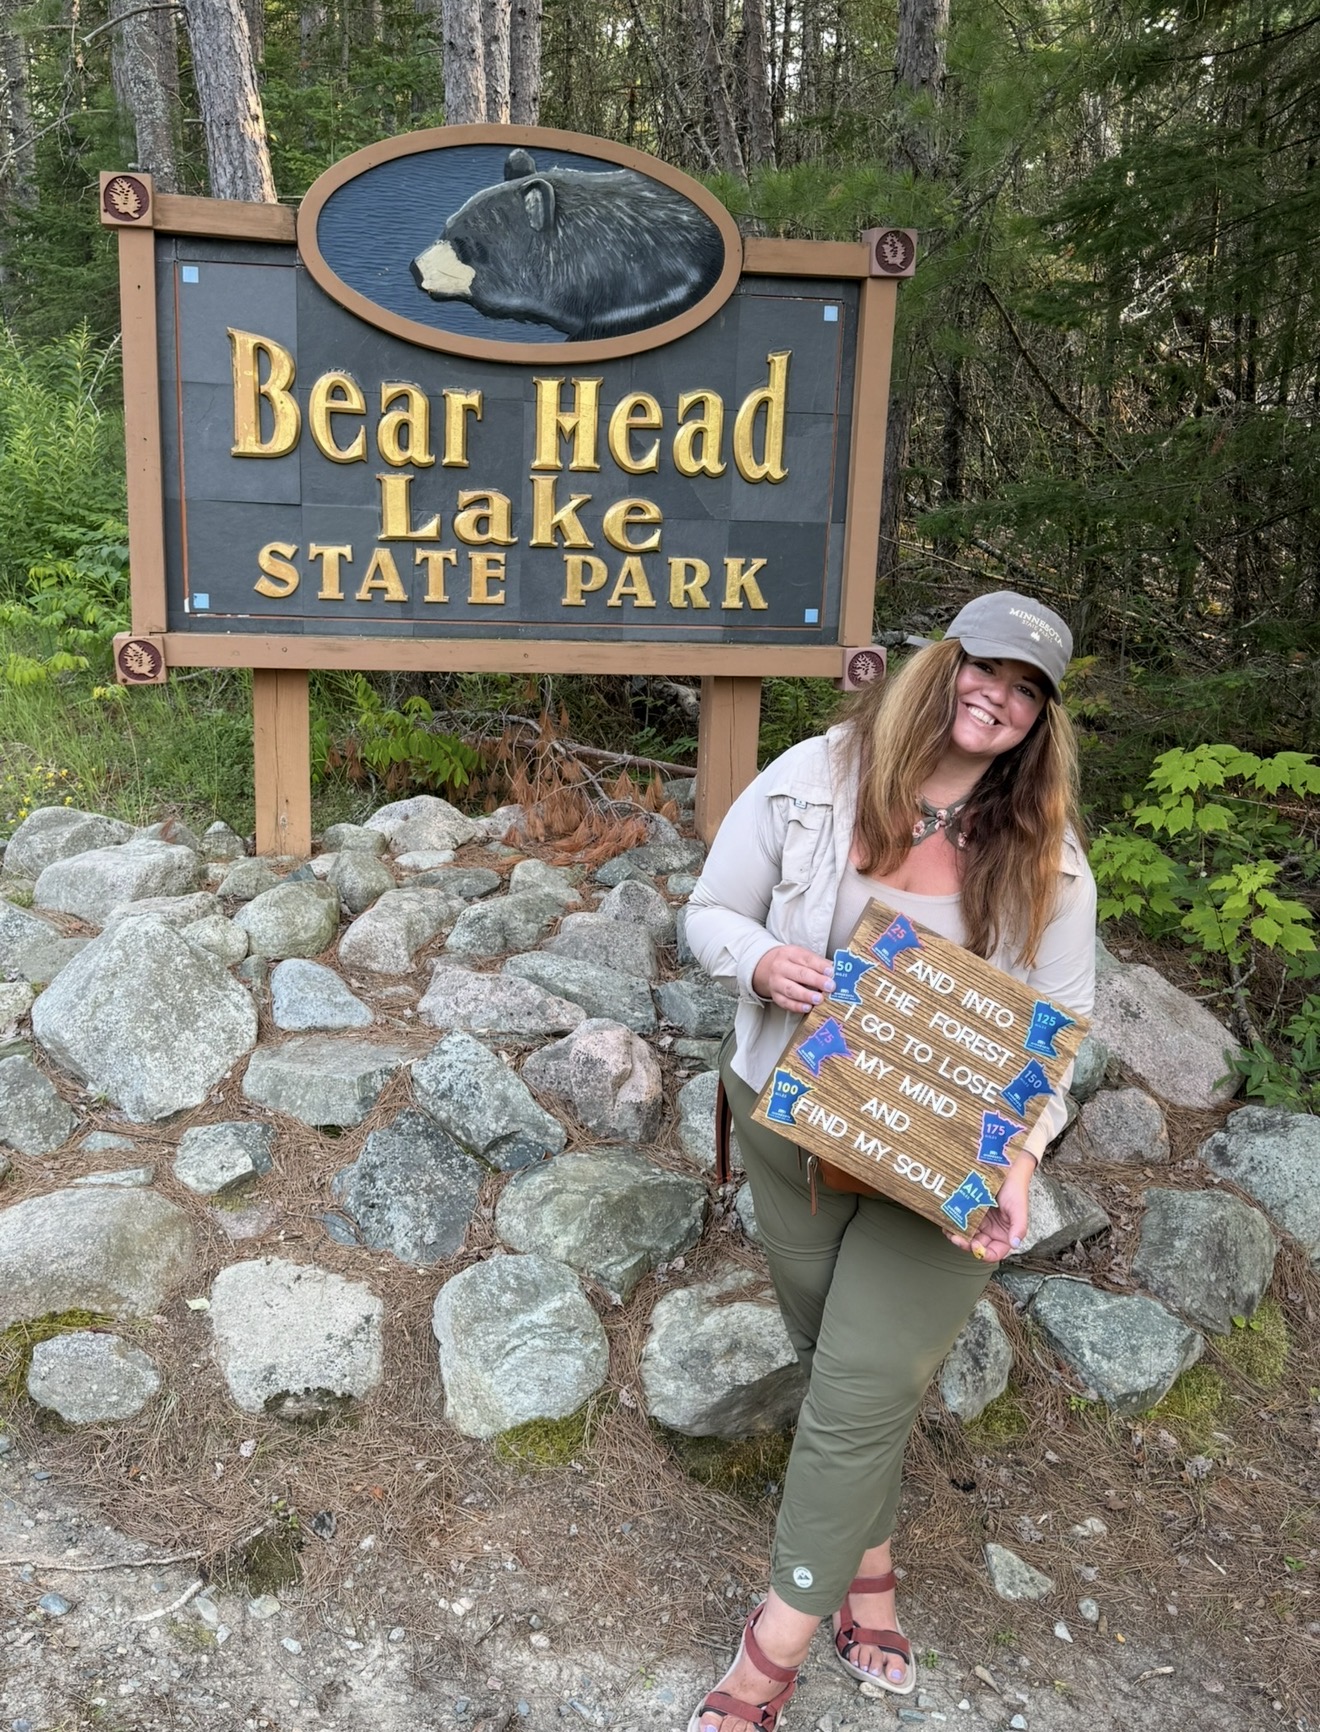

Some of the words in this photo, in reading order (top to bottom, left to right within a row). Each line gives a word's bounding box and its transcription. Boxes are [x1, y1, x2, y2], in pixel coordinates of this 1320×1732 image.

[227, 327, 483, 468] Bear
[531, 350, 792, 484] Head
[376, 472, 663, 552] Lake
[254, 542, 506, 604] STATE
[562, 555, 768, 610] PARK
[1009, 607, 1063, 648] MINNESOTA
[890, 923, 907, 940] 25
[836, 960, 853, 973] 50
[905, 960, 955, 994] AND
[961, 989, 1014, 1028] INTO
[819, 1028, 834, 1043] 75
[874, 977, 920, 1017] THE
[929, 1011, 1015, 1068] FOREST
[1037, 1012, 1056, 1027] 125
[844, 1003, 857, 1021] I
[861, 1013, 895, 1041] GO
[903, 1034, 932, 1063] TO
[938, 1056, 1003, 1104] LOSE
[777, 1081, 798, 1095] 100
[854, 1050, 894, 1080] MY
[898, 1075, 957, 1118] MIND
[1024, 1070, 1042, 1089] 150
[861, 1097, 910, 1132] AND
[986, 1123, 1005, 1136] 175
[794, 1097, 848, 1138] FIND
[854, 1131, 892, 1162] MY
[893, 1154, 947, 1199] SOUL
[963, 1183, 983, 1203] ALL
